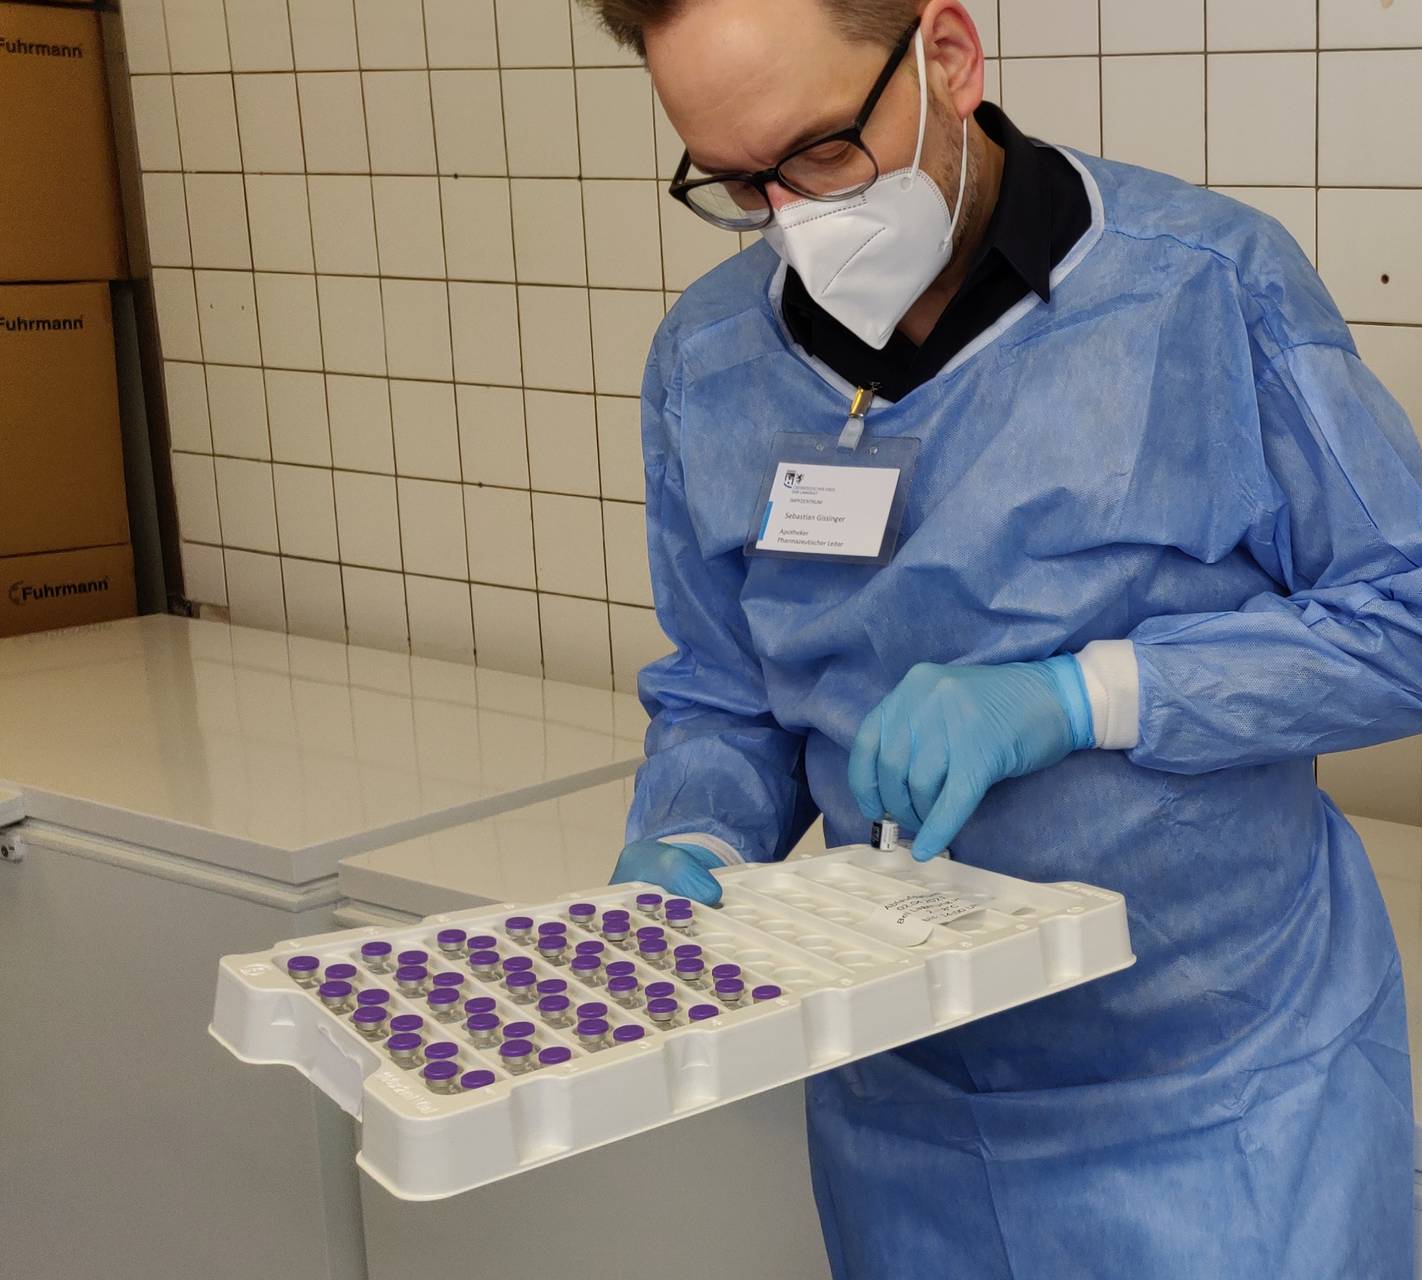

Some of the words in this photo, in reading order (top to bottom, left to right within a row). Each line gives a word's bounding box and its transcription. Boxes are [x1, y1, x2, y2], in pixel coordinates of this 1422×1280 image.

[785, 512, 815, 521] Sebastian
[779, 528, 808, 536] Apotheker
[22, 579, 108, 600] Fuhrmann
